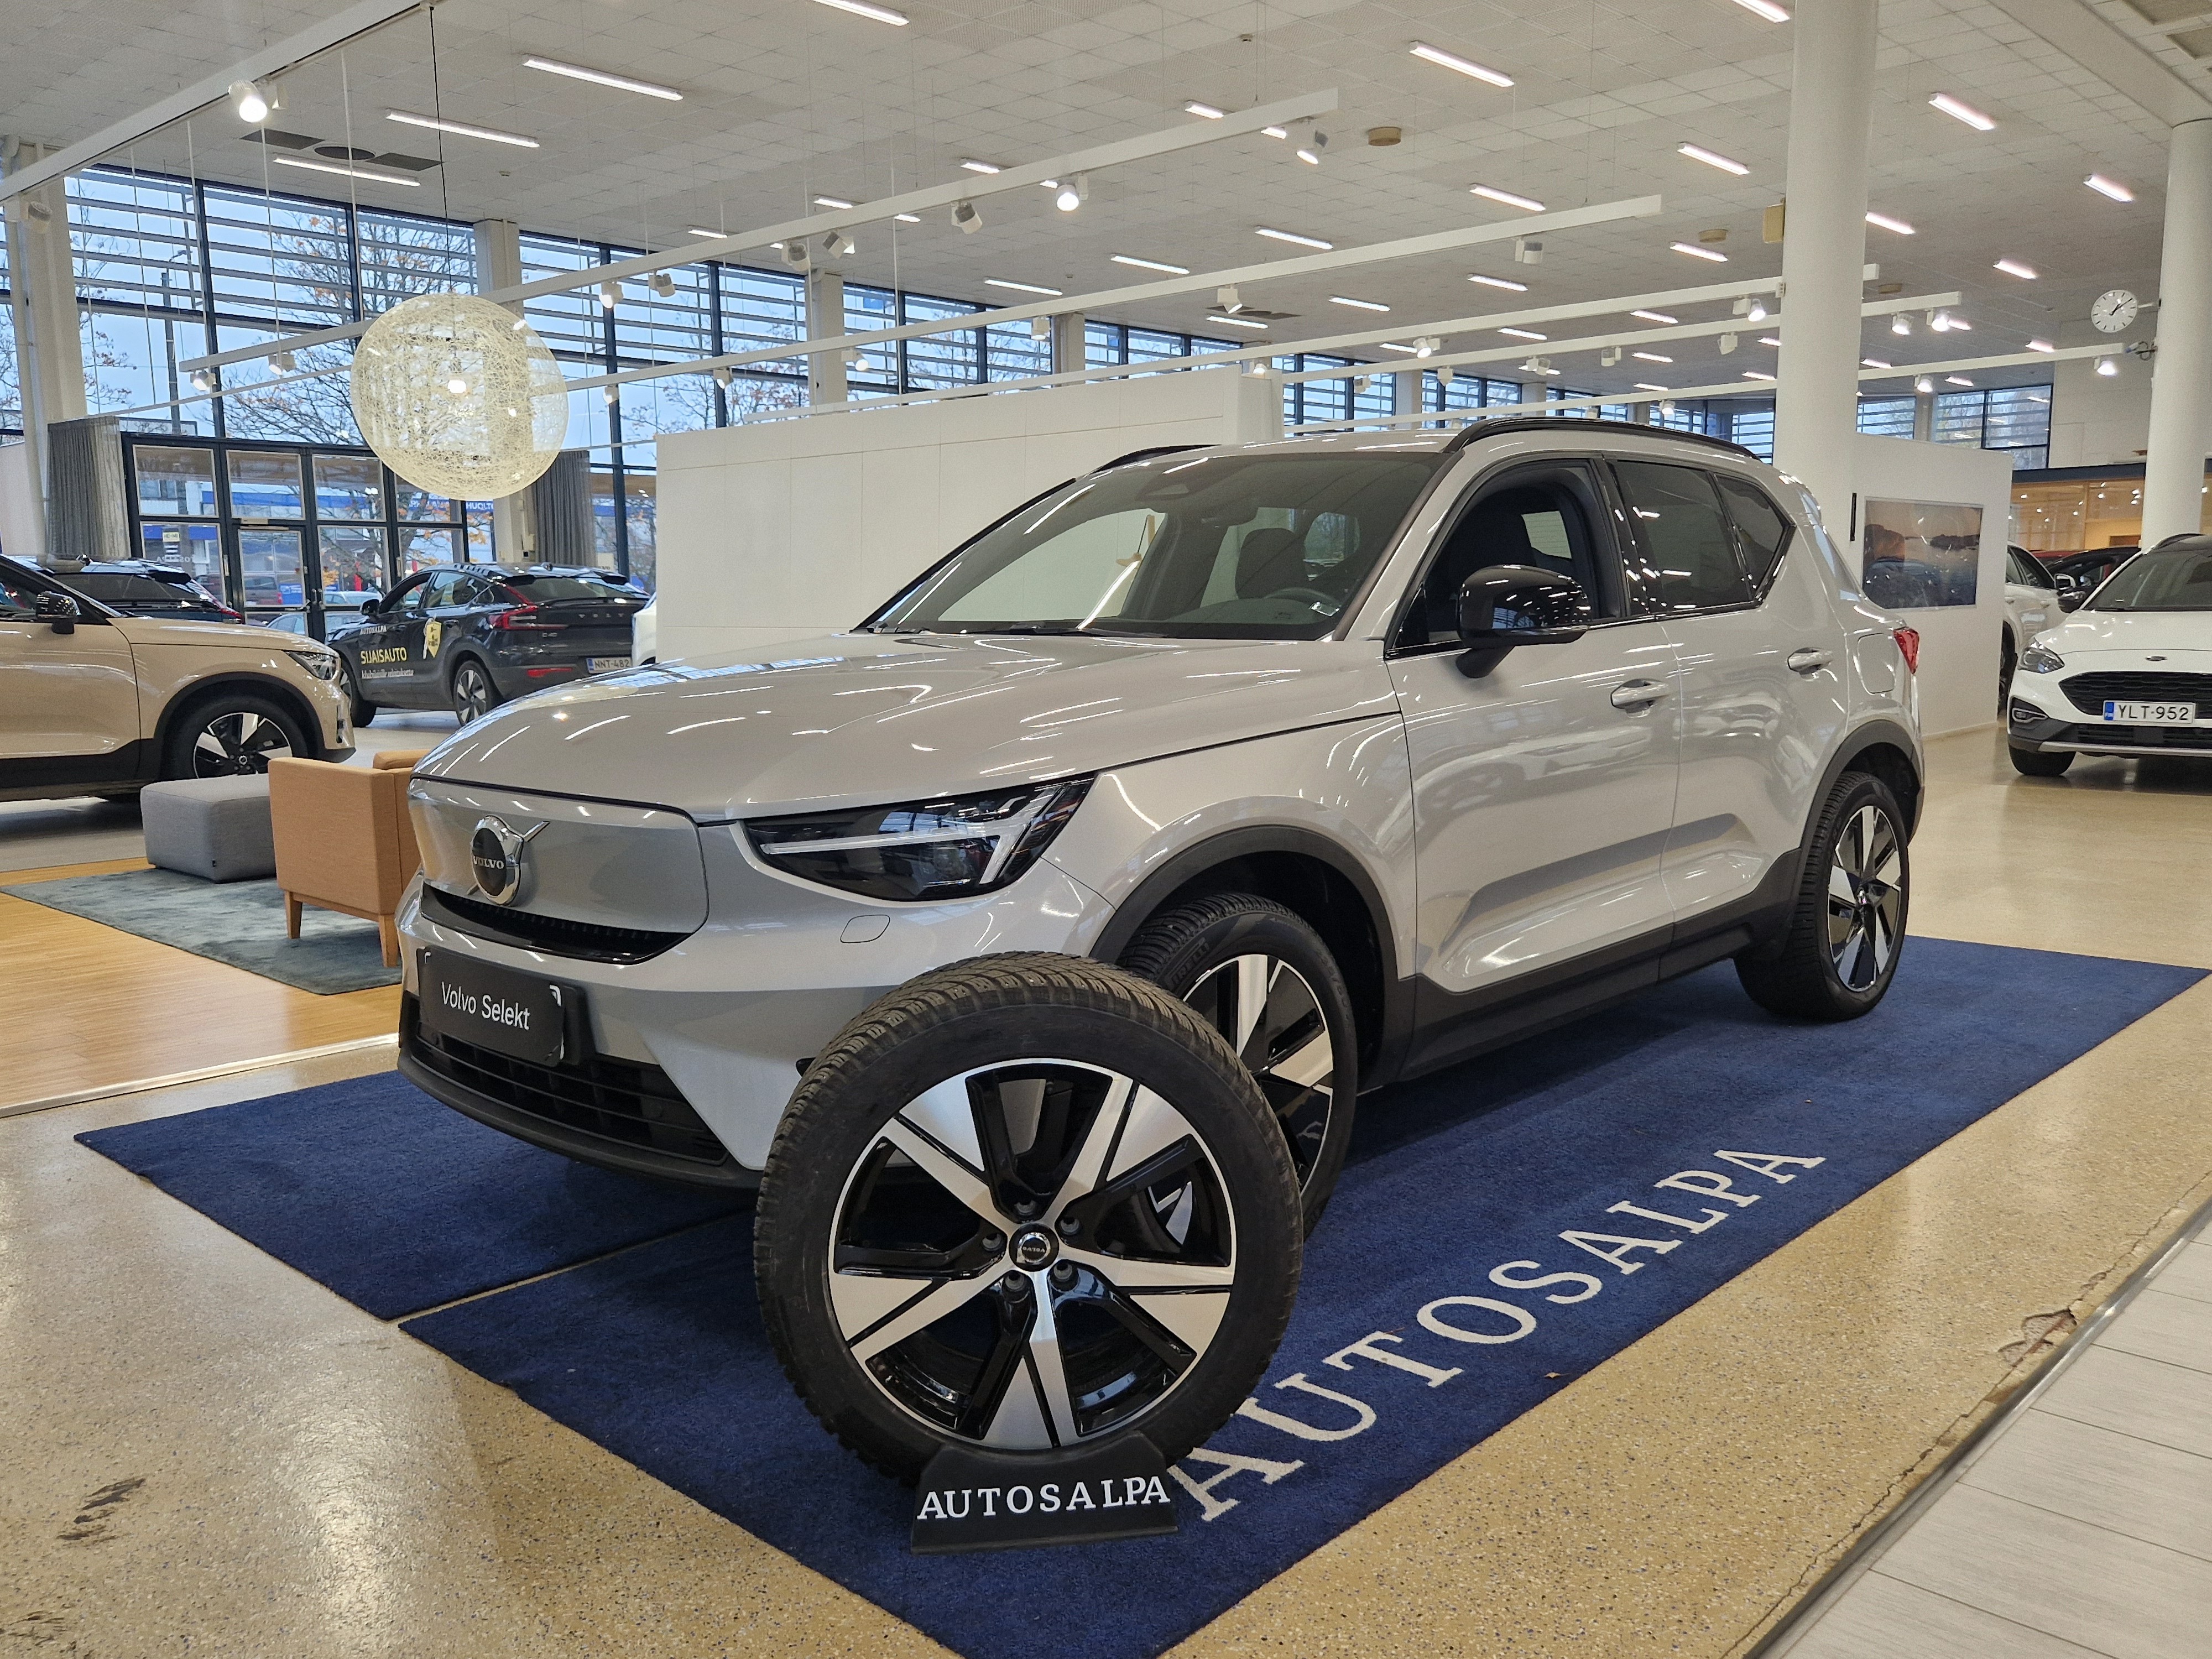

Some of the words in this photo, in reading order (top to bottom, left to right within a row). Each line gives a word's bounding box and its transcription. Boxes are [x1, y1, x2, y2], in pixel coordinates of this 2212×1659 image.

[360, 625, 387, 635] AUTOSALPA
[360, 647, 407, 665] SIJAISAUTO
[594, 659, 630, 669] NNT-482
[2118, 705, 2189, 721] YLT-952
[473, 855, 504, 869] VOLVO
[441, 981, 477, 1015] Volvo
[481, 994, 530, 1031] Selekt
[1166, 1149, 1827, 1522] AUTOSALPA
[916, 1475, 1171, 1520] AUTOSALPA
